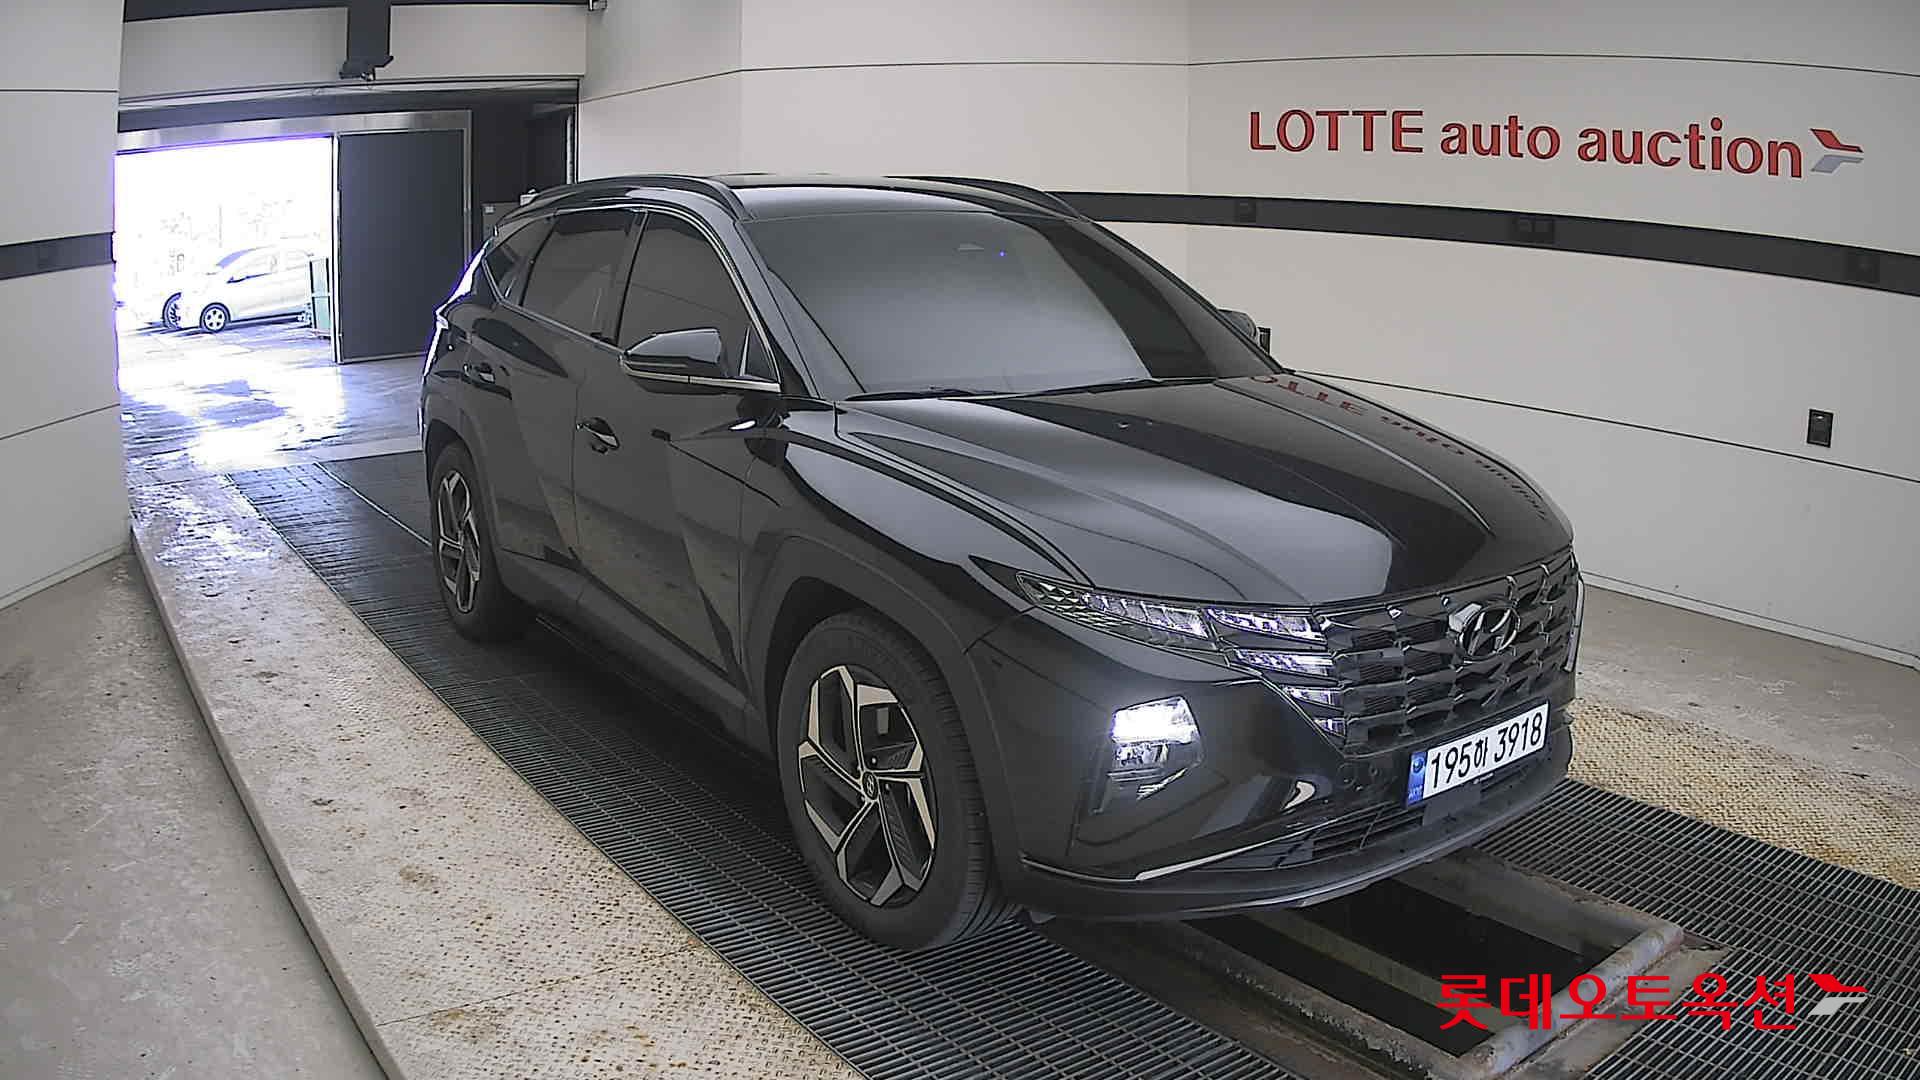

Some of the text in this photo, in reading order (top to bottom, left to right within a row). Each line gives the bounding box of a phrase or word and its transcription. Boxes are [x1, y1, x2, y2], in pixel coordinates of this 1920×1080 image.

[1249, 109, 1804, 178] LOTTE auto auction
[1431, 712, 1543, 789] 195하 3918
